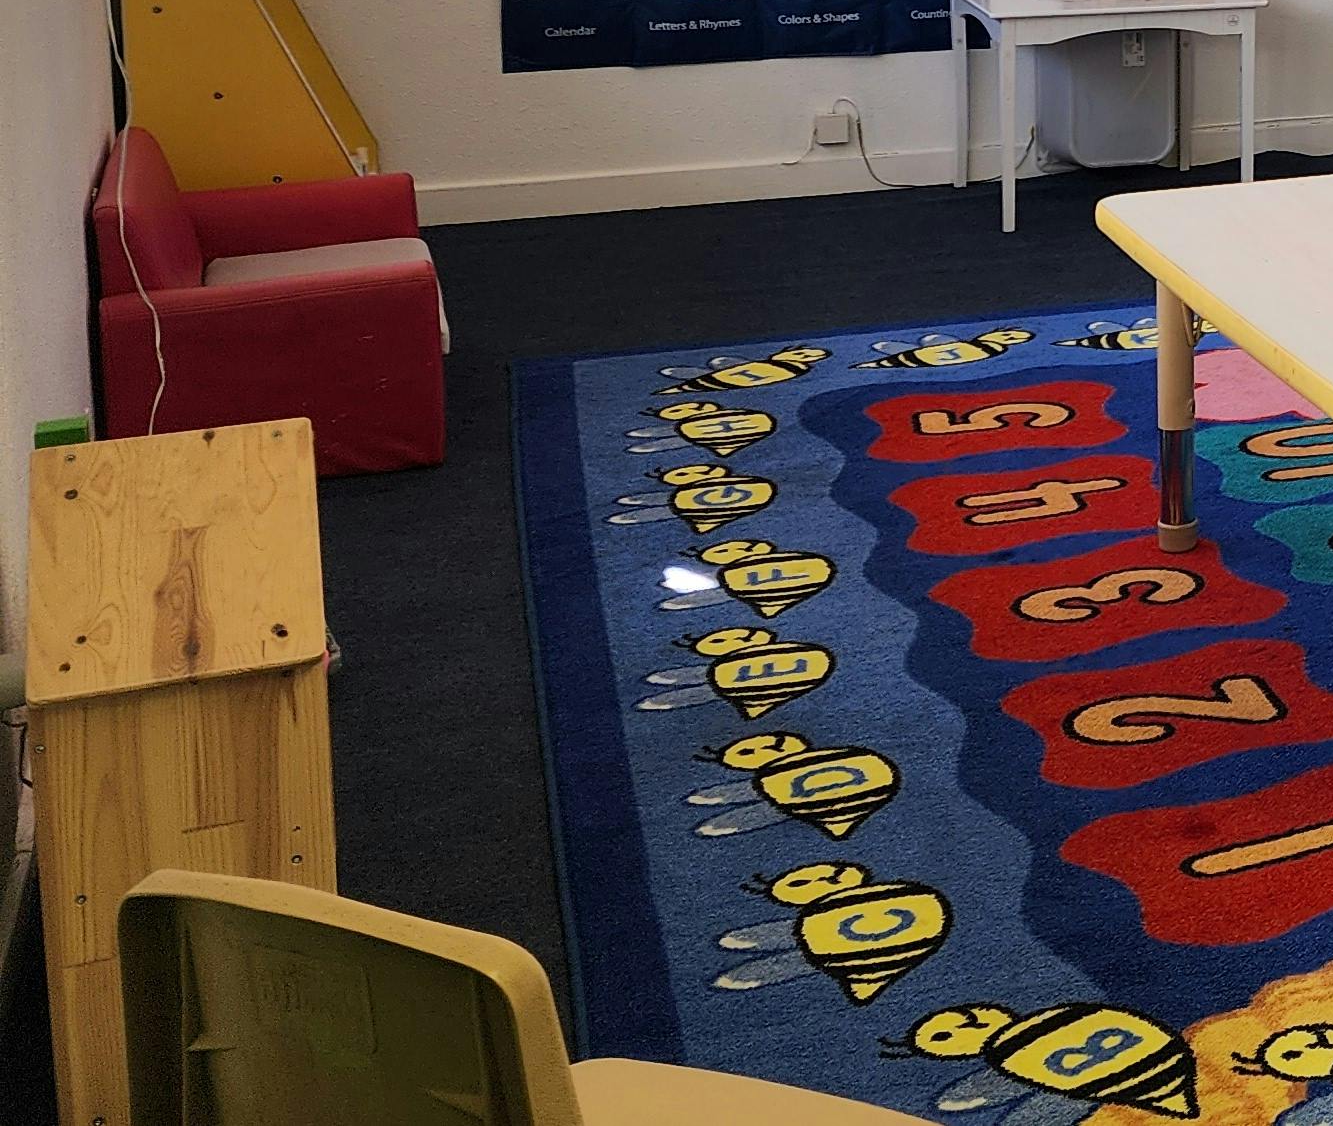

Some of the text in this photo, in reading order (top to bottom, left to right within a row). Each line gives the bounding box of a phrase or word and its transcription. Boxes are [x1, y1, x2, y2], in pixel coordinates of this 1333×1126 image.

[648, 16, 741, 32] Letters & Rhymes
[778, 12, 859, 25] Colors & Shapes
[910, 9, 952, 21] Countin
[545, 25, 596, 38] Calendar
[937, 348, 963, 362] J
[708, 419, 749, 434] H
[911, 400, 1076, 436] 5
[693, 485, 752, 505] G
[955, 474, 1128, 527] 4
[746, 561, 811, 586] F
[1012, 566, 1206, 623] 3
[731, 657, 809, 684] E
[1062, 675, 1287, 745] 2
[790, 766, 868, 801] D
[837, 907, 917, 942] C
[1042, 1027, 1140, 1077] B
